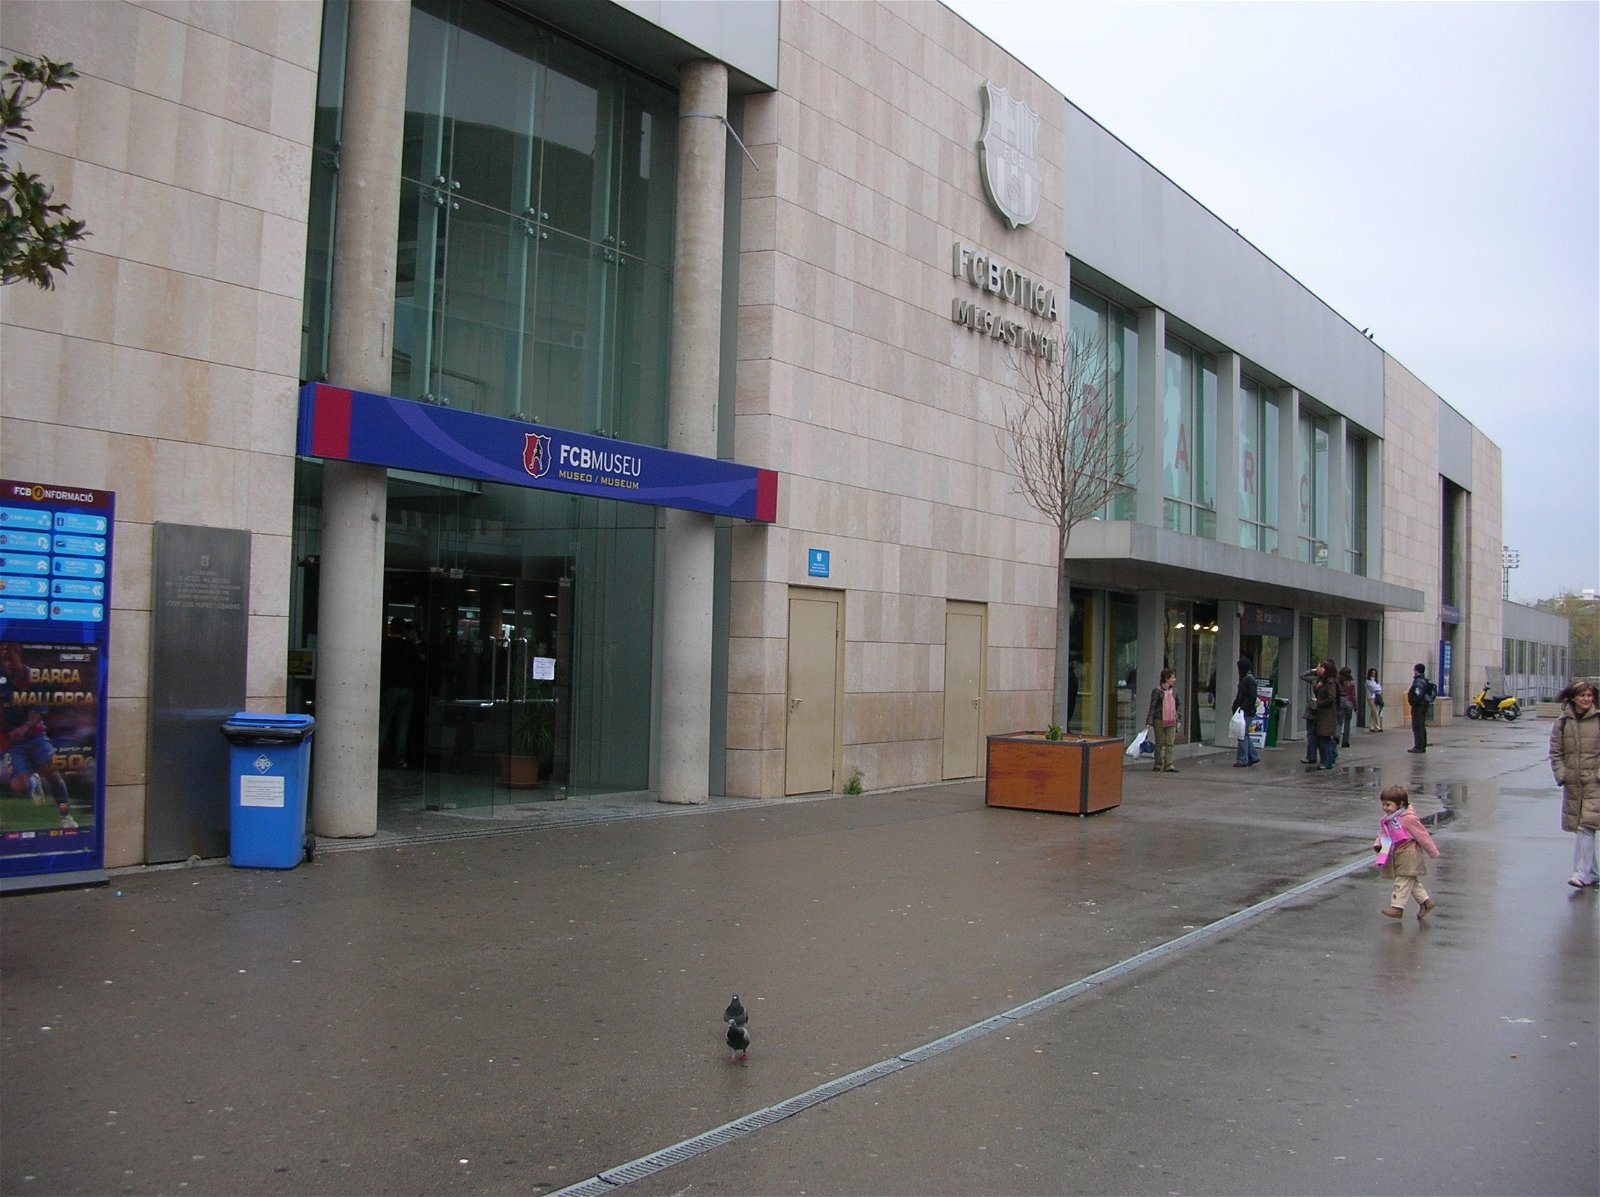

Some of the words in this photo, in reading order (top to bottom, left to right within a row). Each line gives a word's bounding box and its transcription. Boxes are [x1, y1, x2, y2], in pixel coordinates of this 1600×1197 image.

[952, 241, 1057, 321] FCBOTIGA
[560, 444, 641, 477] FCBMUSEU
[558, 469, 593, 483] MUSEO
[600, 476, 639, 490] MUSEUM
[13, 691, 94, 706] MALLORCA
